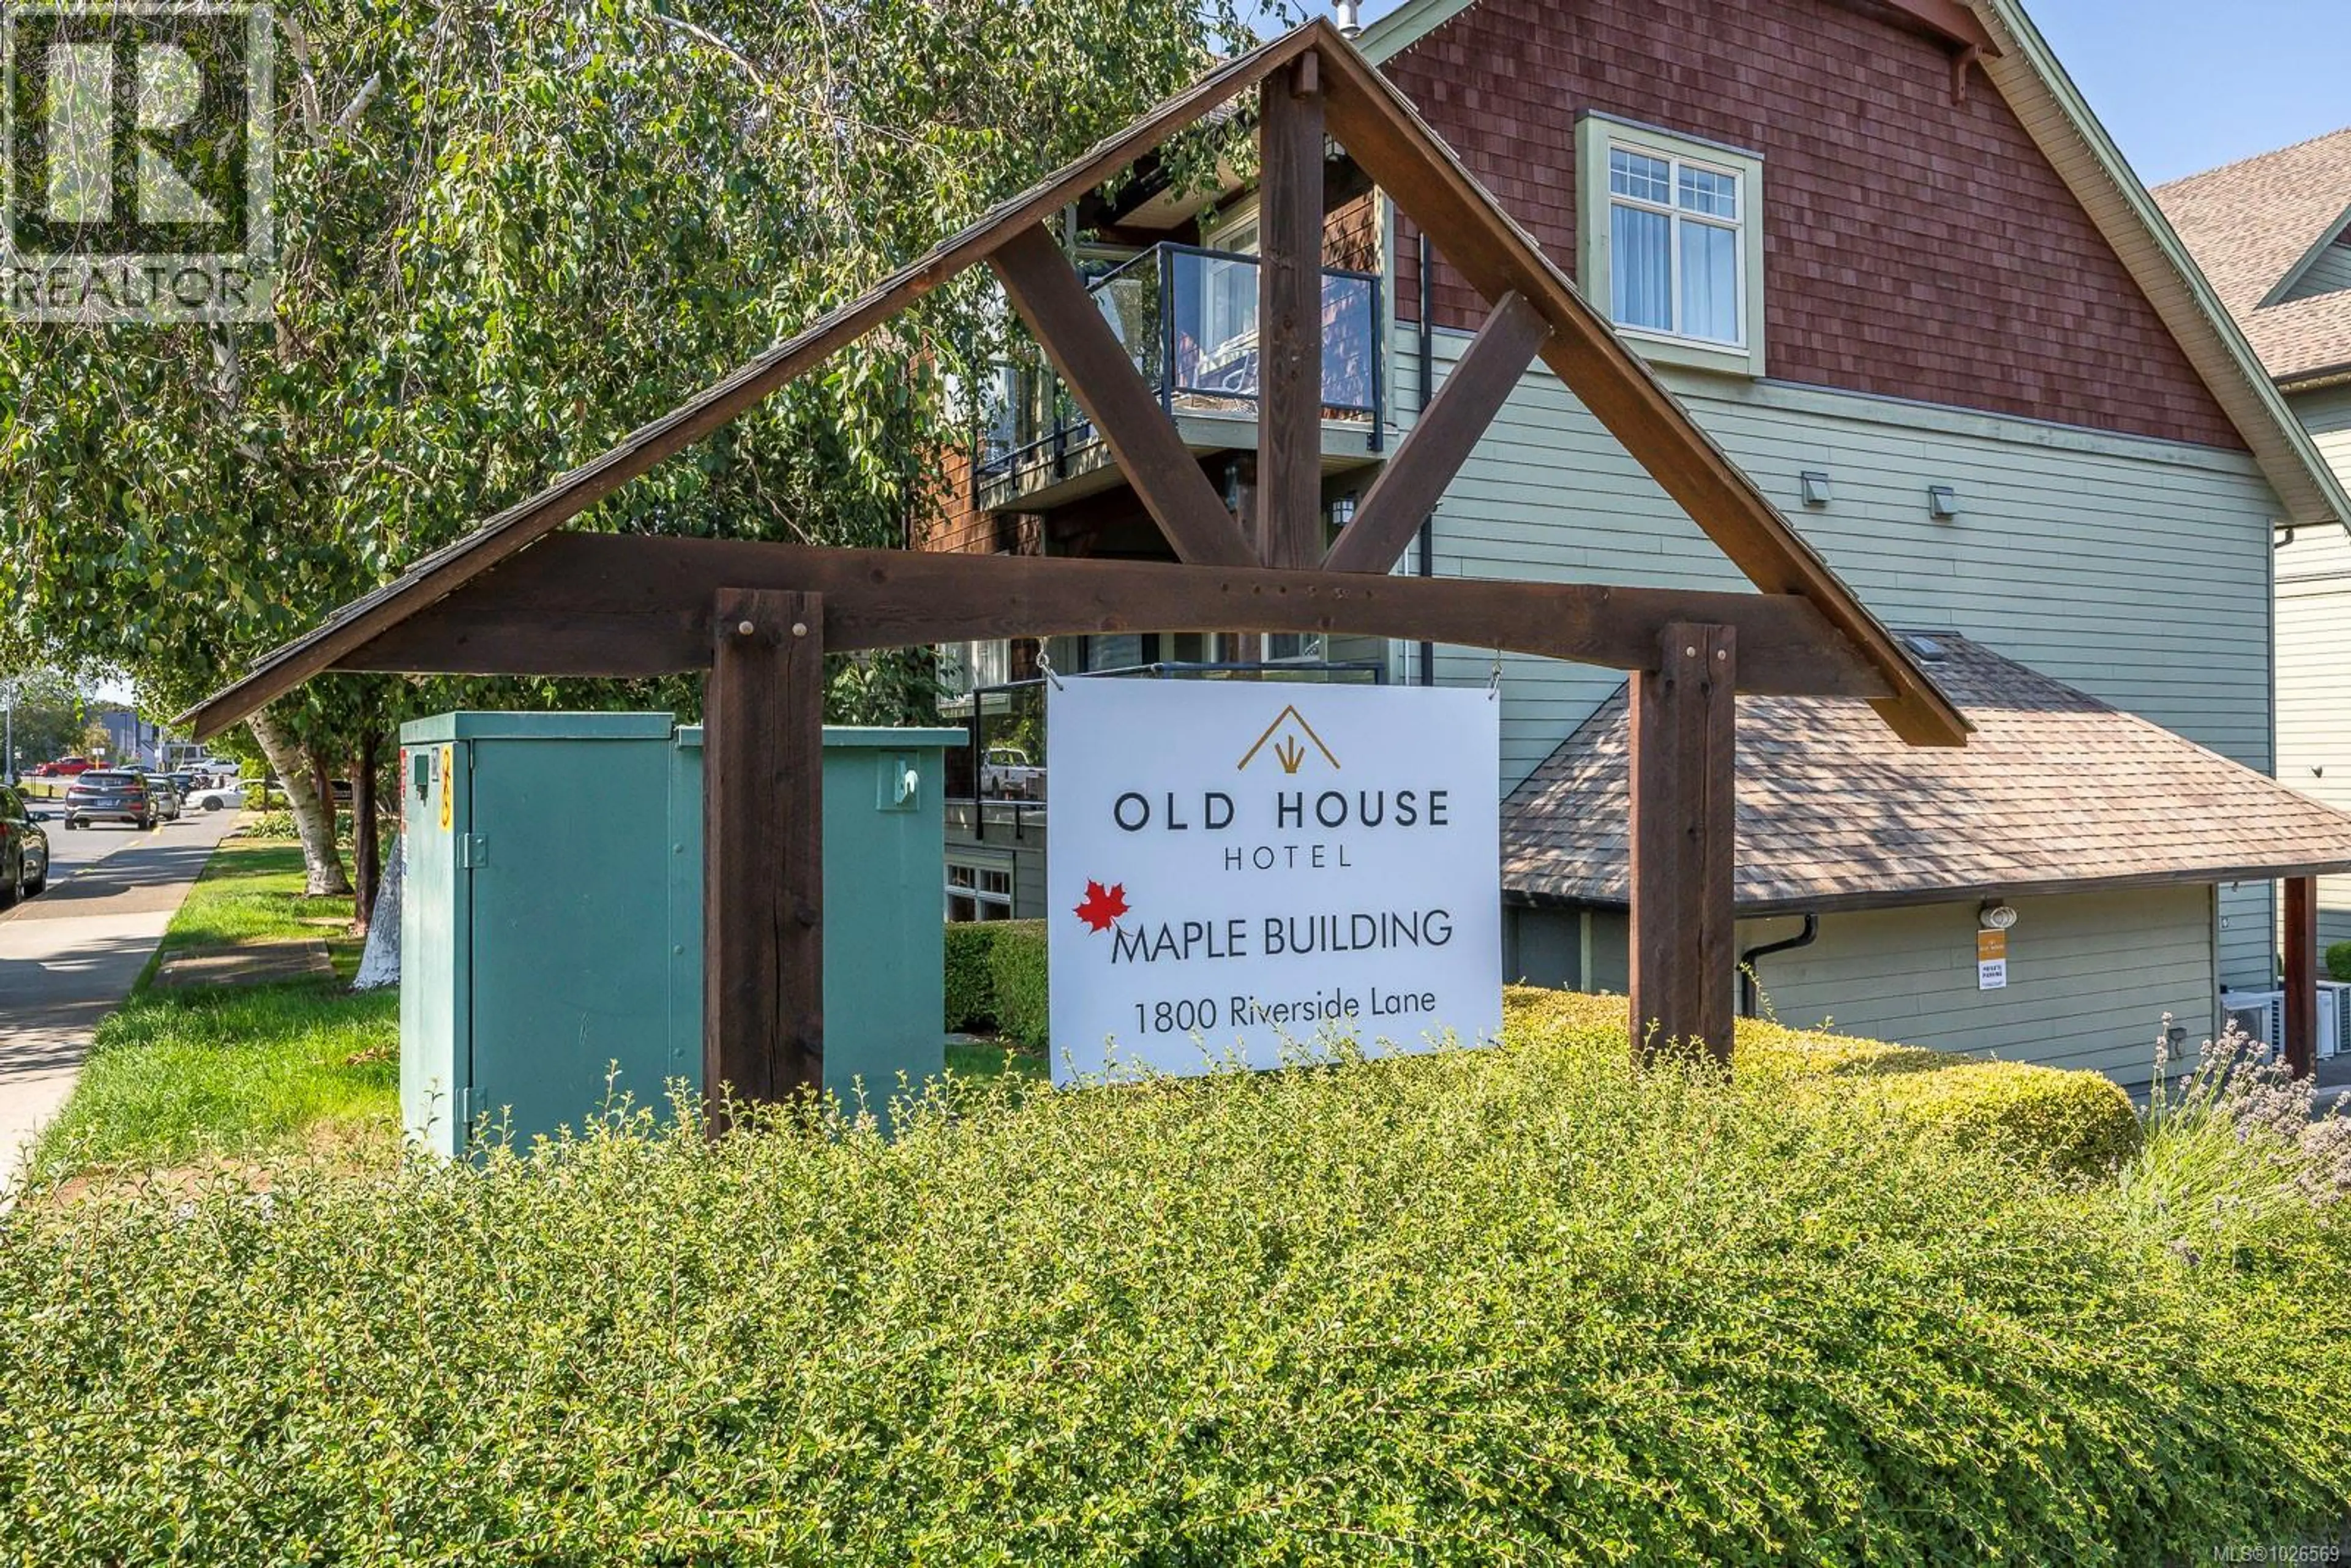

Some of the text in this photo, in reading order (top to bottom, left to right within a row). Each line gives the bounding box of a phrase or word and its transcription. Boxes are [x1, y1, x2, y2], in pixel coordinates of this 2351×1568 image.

[1114, 790, 1449, 831] OLD HOUSE
[1224, 844, 1352, 871] HOTEL
[1111, 909, 1453, 964] MAPLE BUILDING
[1134, 987, 1436, 1034] 1800 Riverside Lane
